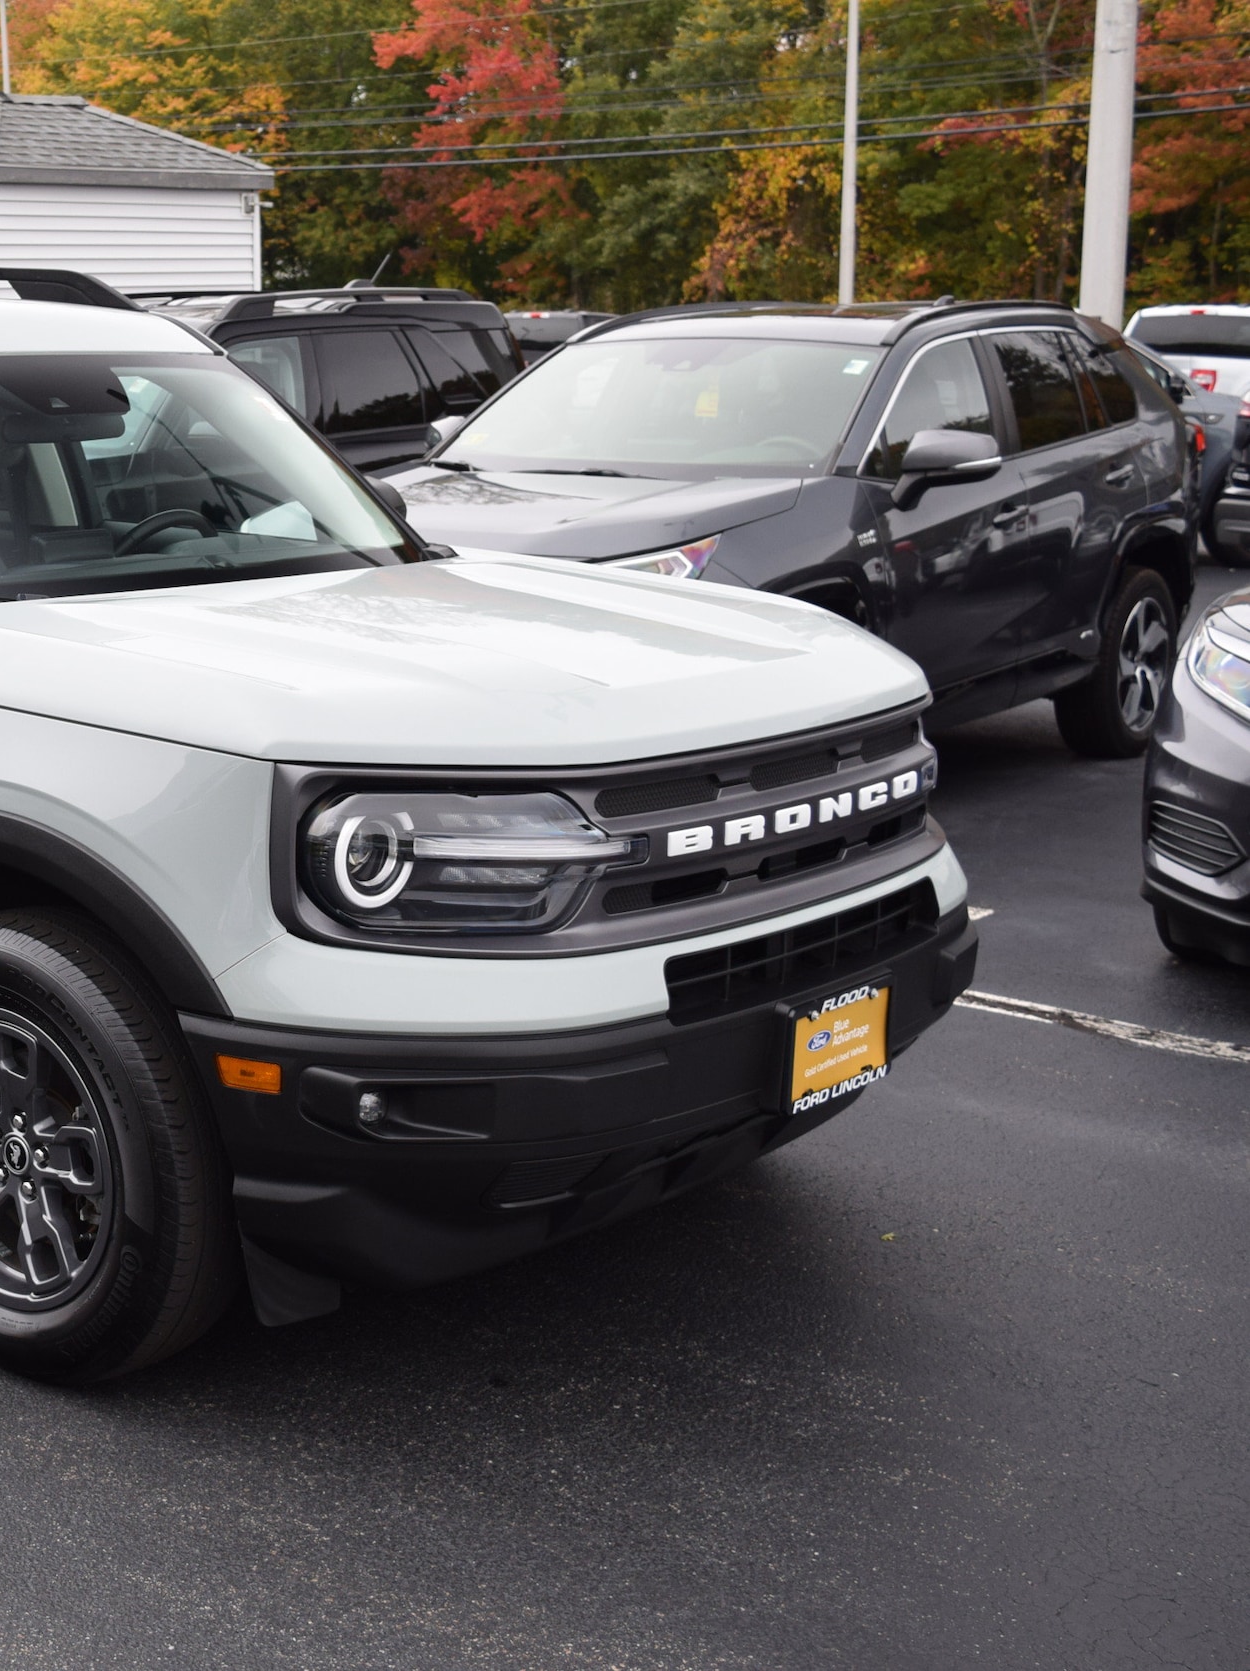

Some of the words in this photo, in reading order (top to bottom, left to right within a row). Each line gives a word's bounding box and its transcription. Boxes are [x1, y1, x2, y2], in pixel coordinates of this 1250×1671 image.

[667, 770, 918, 857] BRONCO
[820, 986, 869, 1014] FLOOD
[832, 1024, 870, 1047] Advantage
[833, 1019, 850, 1033] Blue
[810, 1032, 829, 1050] Ford
[793, 1088, 830, 1115] FORD
[831, 1064, 888, 1099] LINCOLN
